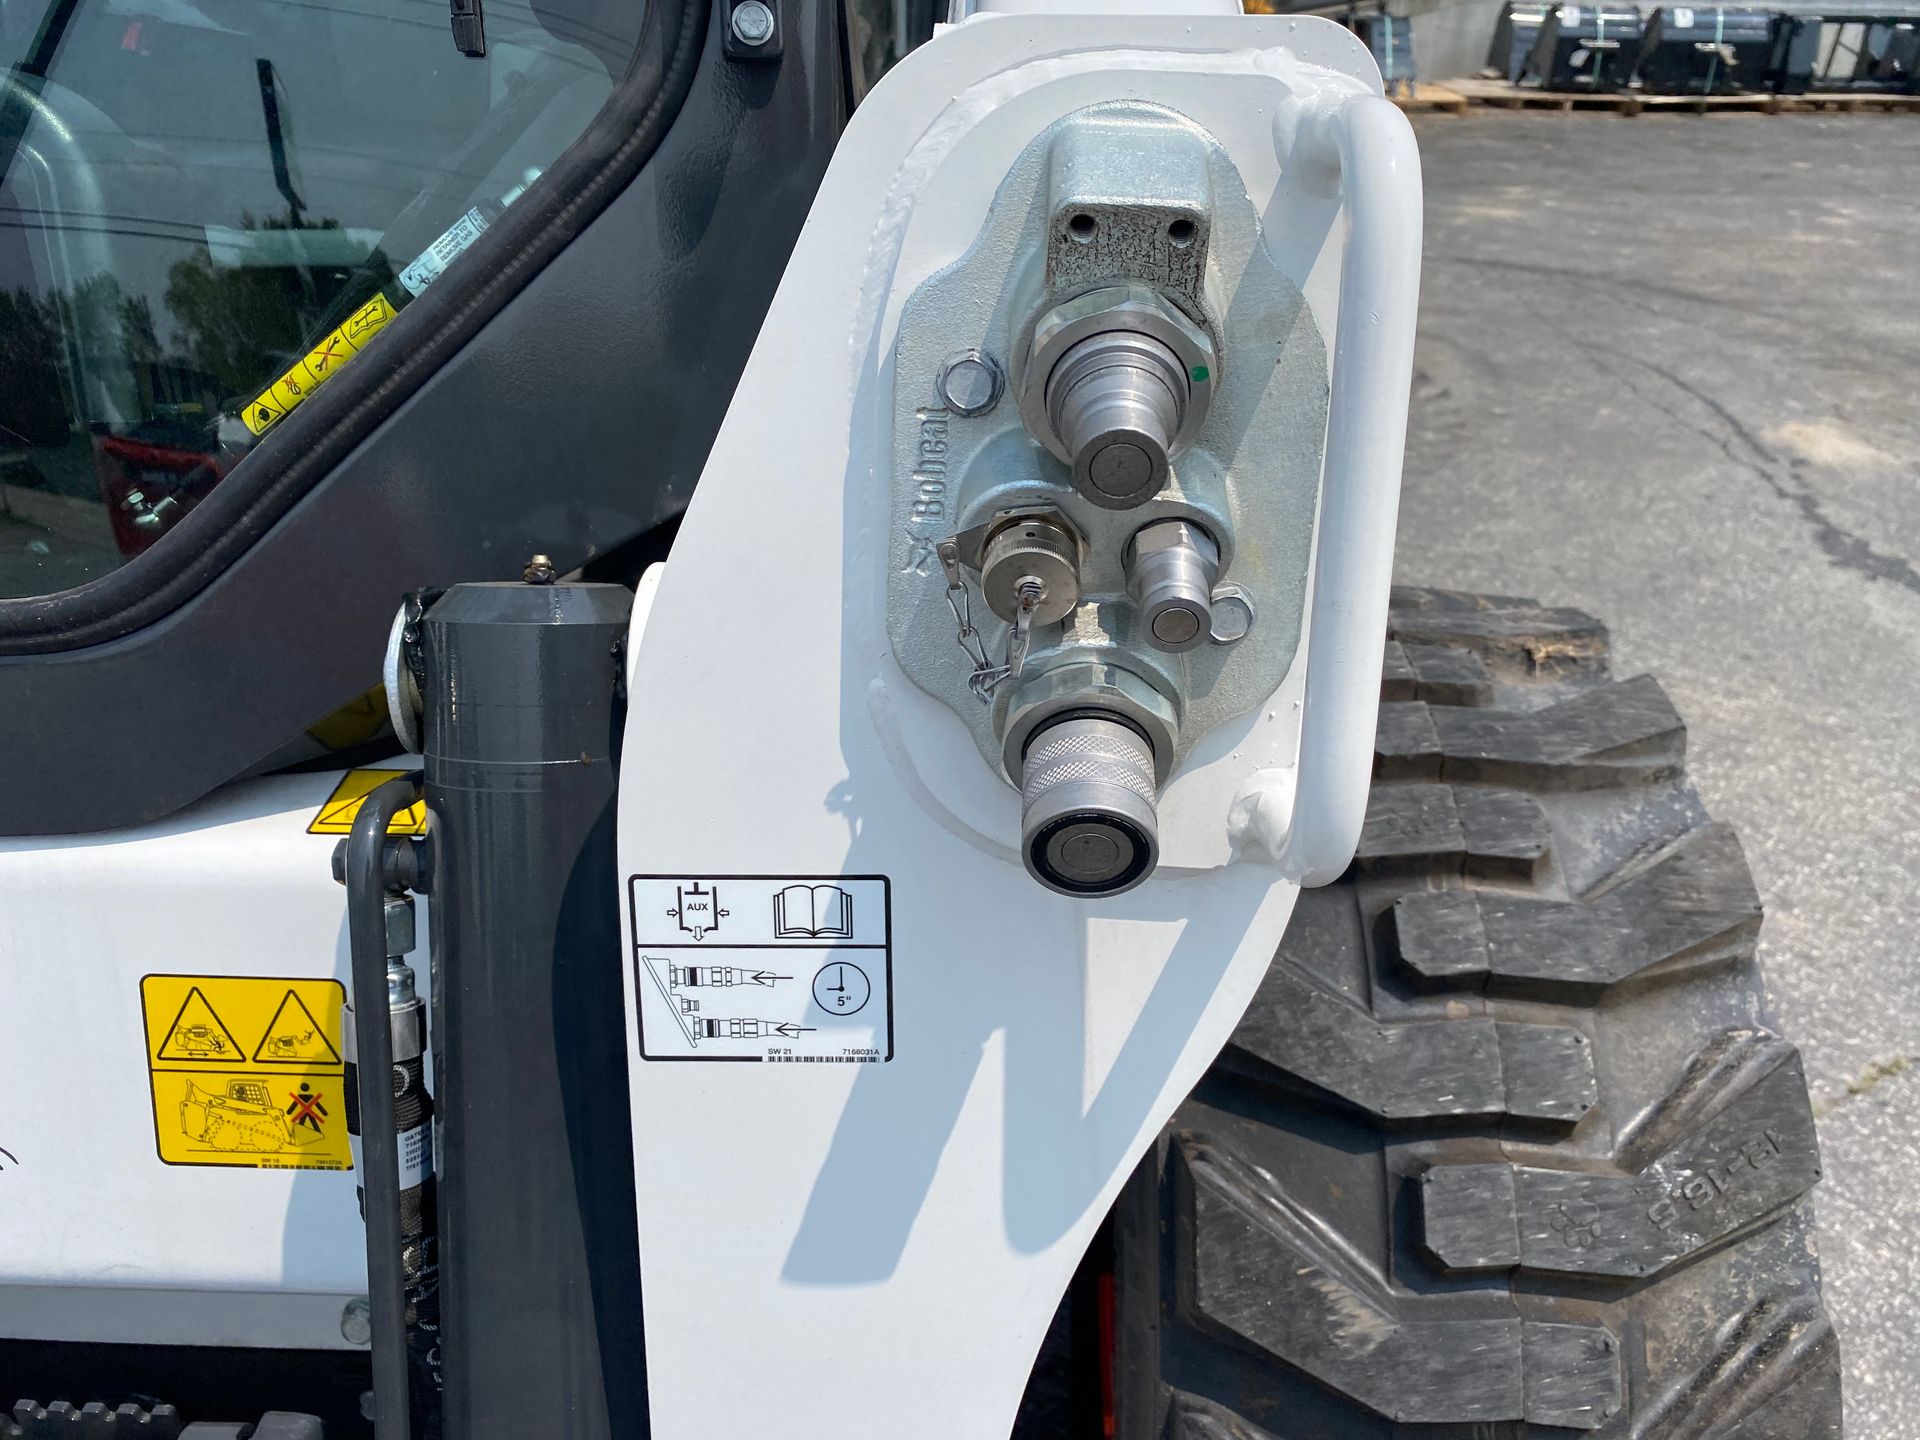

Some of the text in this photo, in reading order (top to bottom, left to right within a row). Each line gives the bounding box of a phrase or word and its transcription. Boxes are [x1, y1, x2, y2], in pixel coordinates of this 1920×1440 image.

[435, 231, 461, 256] RETAINER
[458, 225, 468, 236] TO
[440, 240, 462, 262] REMOVE
[460, 230, 473, 242] GAS
[911, 406, 950, 522] Bobcat
[687, 903, 708, 911] AUX
